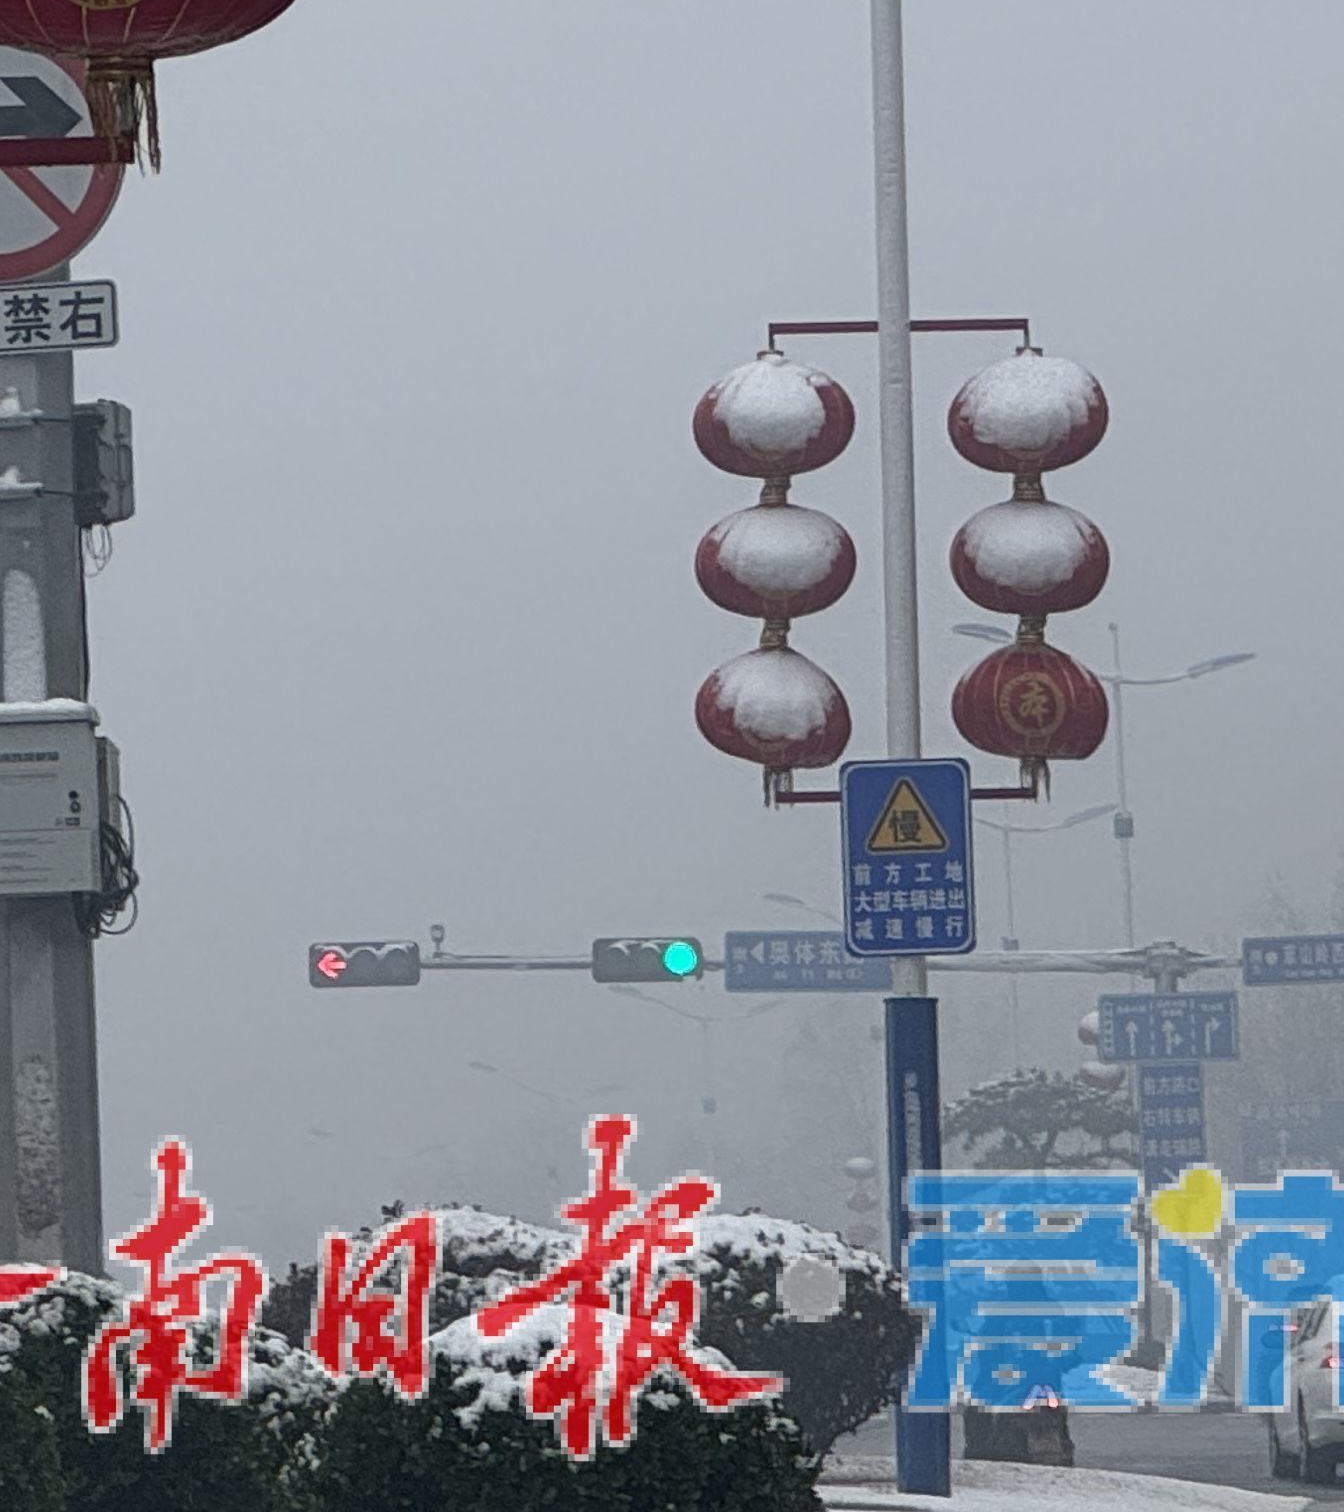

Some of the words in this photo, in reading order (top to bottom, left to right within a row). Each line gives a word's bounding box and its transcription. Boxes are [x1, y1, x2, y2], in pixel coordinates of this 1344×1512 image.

[889, 810, 921, 842] 慢
[853, 861, 964, 886] 前方工地
[854, 888, 965, 912] 大型车辆进出
[855, 916, 964, 941] 减速慢行
